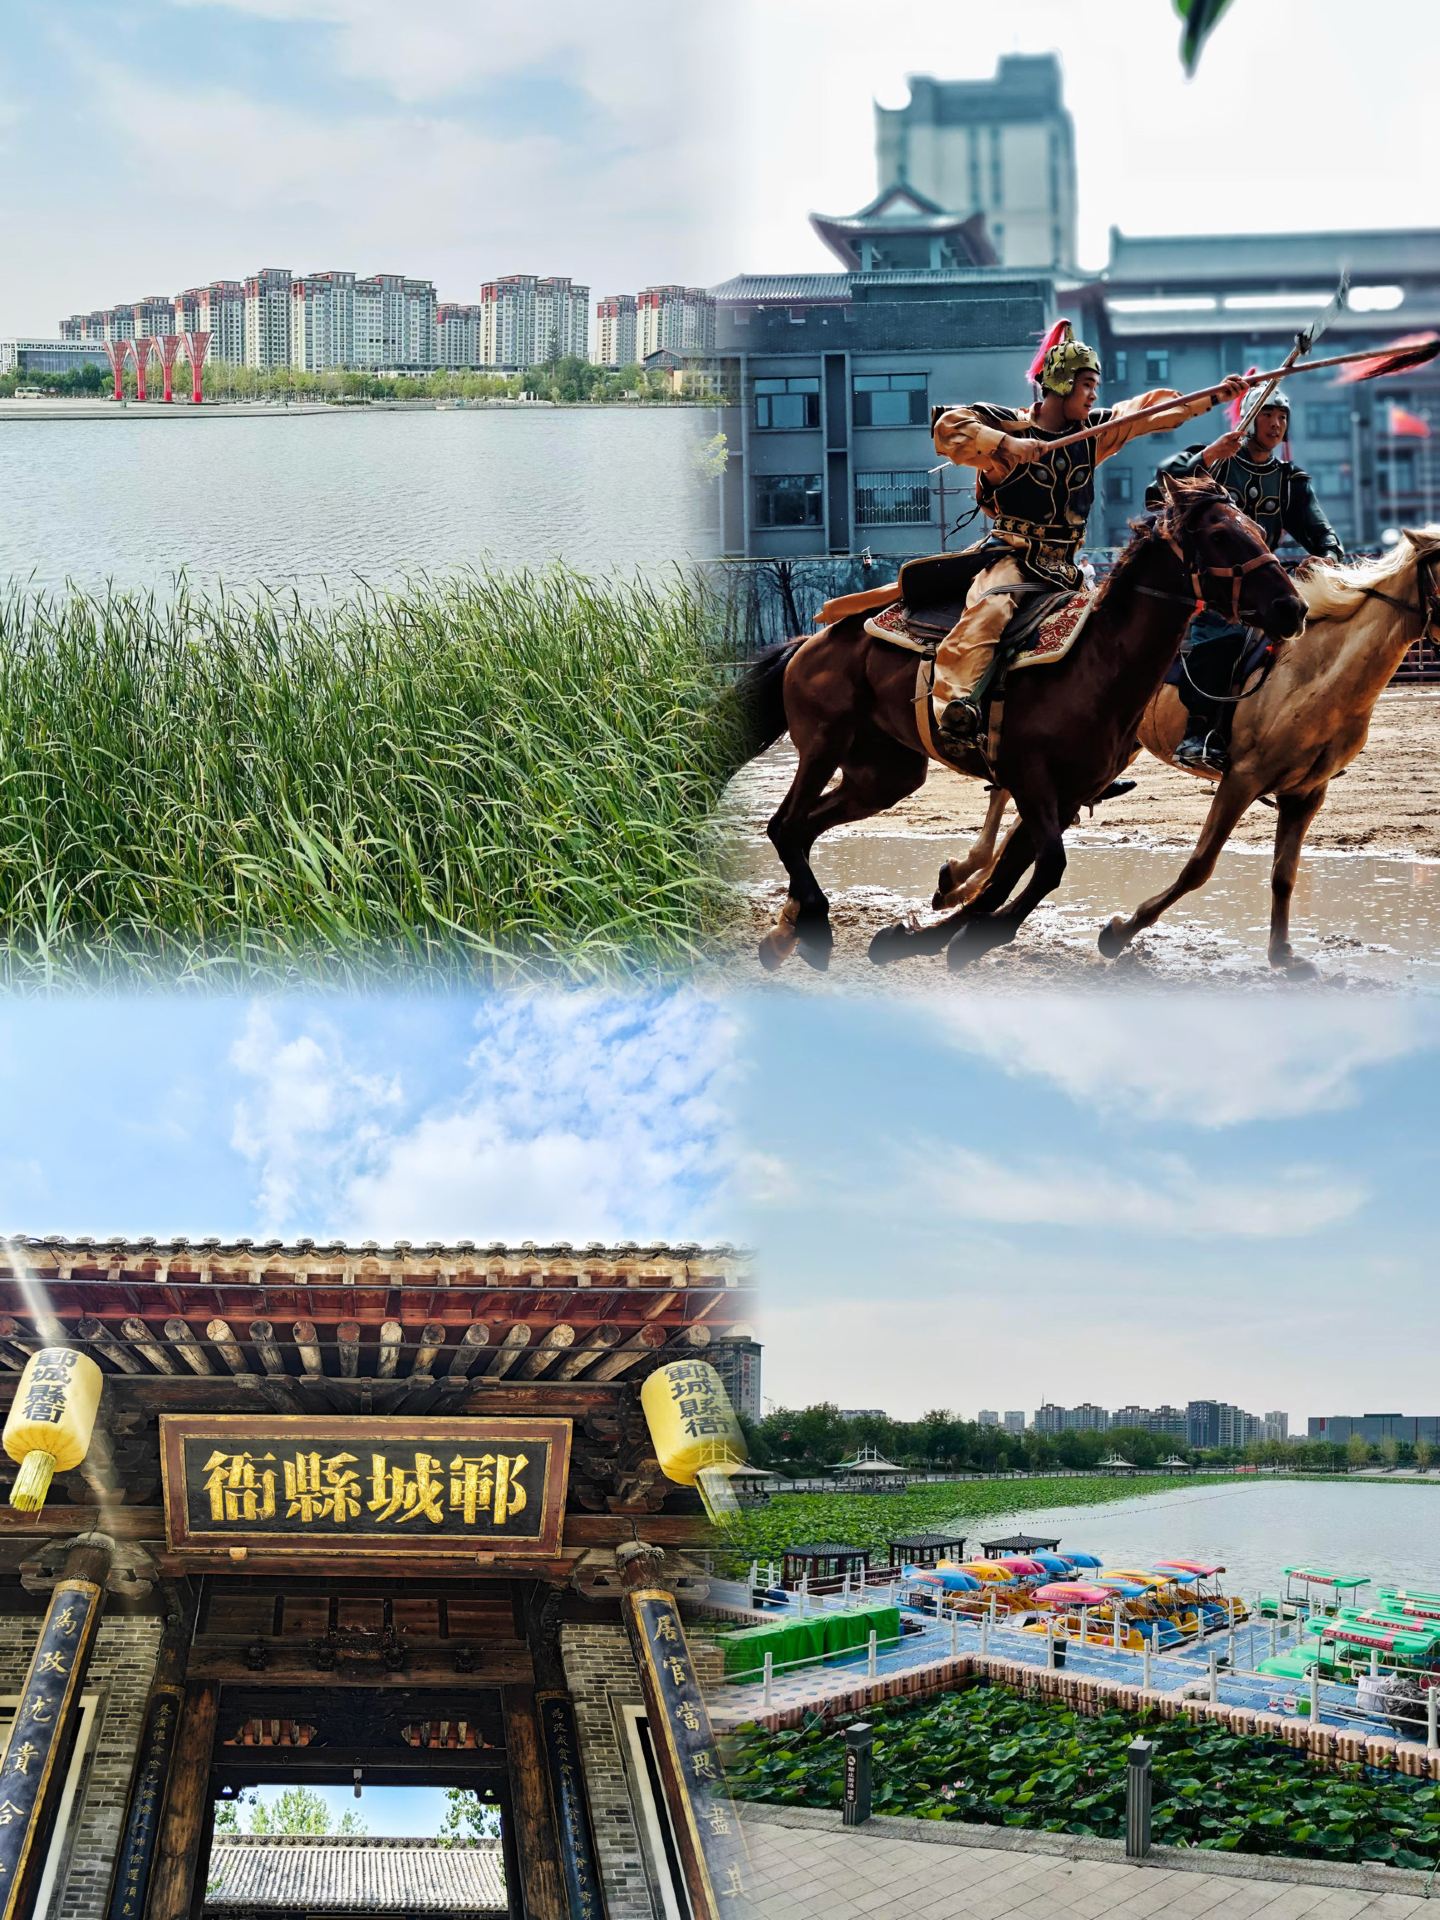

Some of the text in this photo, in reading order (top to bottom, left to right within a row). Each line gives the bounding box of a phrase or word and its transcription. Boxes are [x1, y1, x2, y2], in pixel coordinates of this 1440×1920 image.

[22, 1350, 80, 1424] 鄆城縣衙
[664, 1362, 730, 1438] 鄆城縣衙
[203, 1449, 529, 1525] 鄆城縣衙
[0, 1607, 77, 1873] 為政尤貴合
